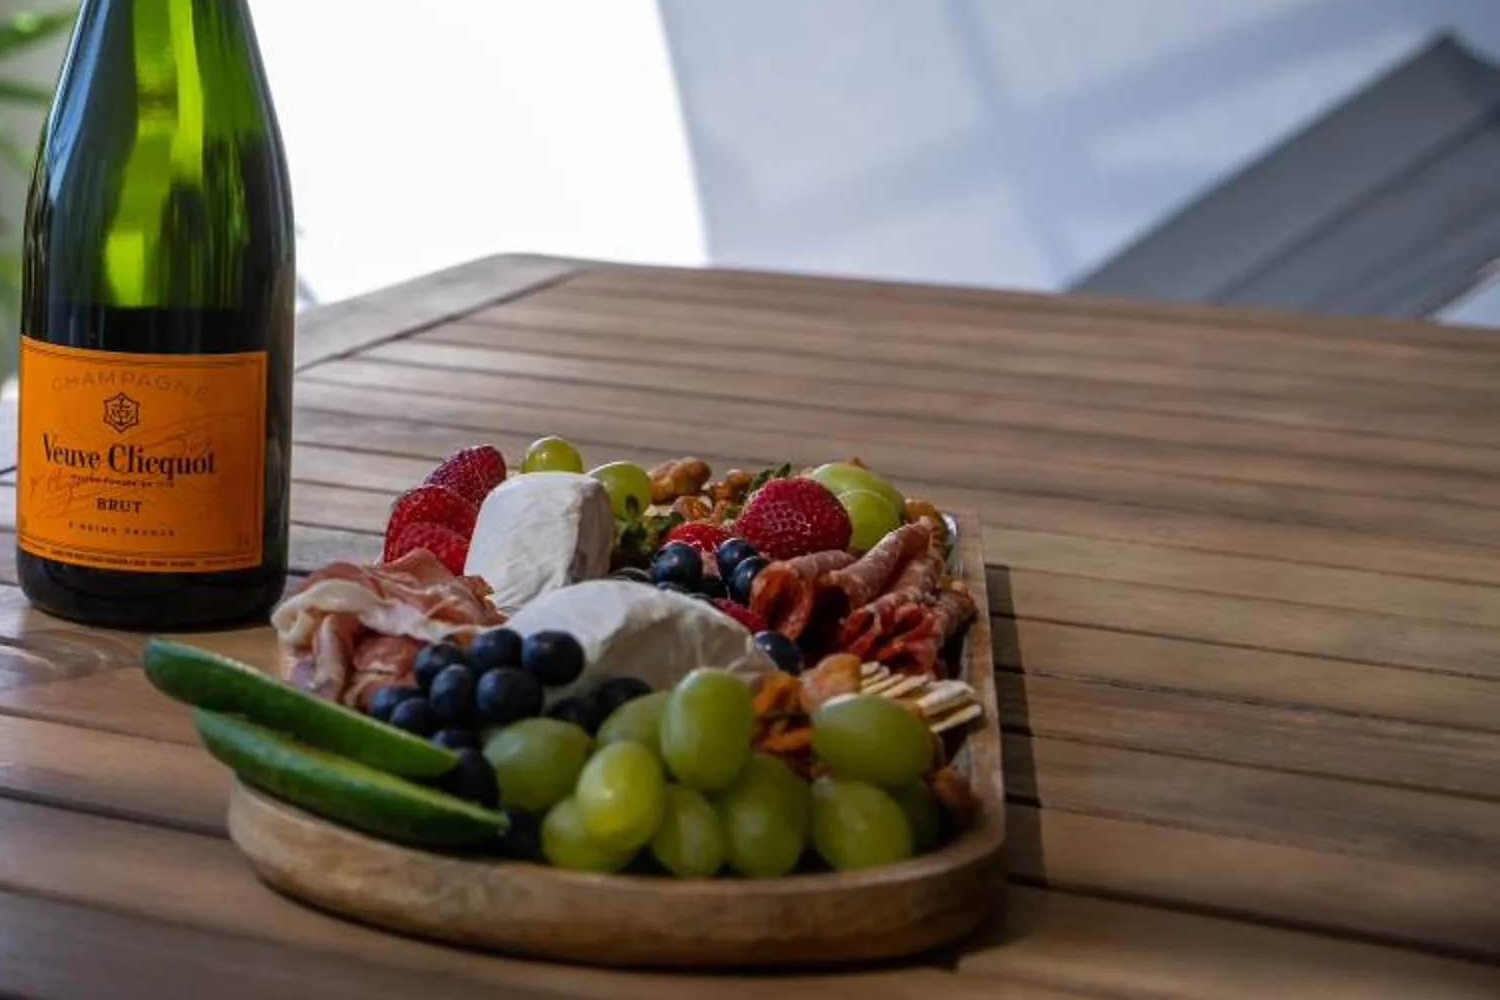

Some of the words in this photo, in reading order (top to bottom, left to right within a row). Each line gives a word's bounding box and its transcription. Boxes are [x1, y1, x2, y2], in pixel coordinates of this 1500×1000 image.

[51, 369, 211, 398] CHAMPAGNE
[42, 431, 101, 469] Veuve
[107, 442, 217, 481] Clicquot
[96, 497, 143, 515] BRUT
